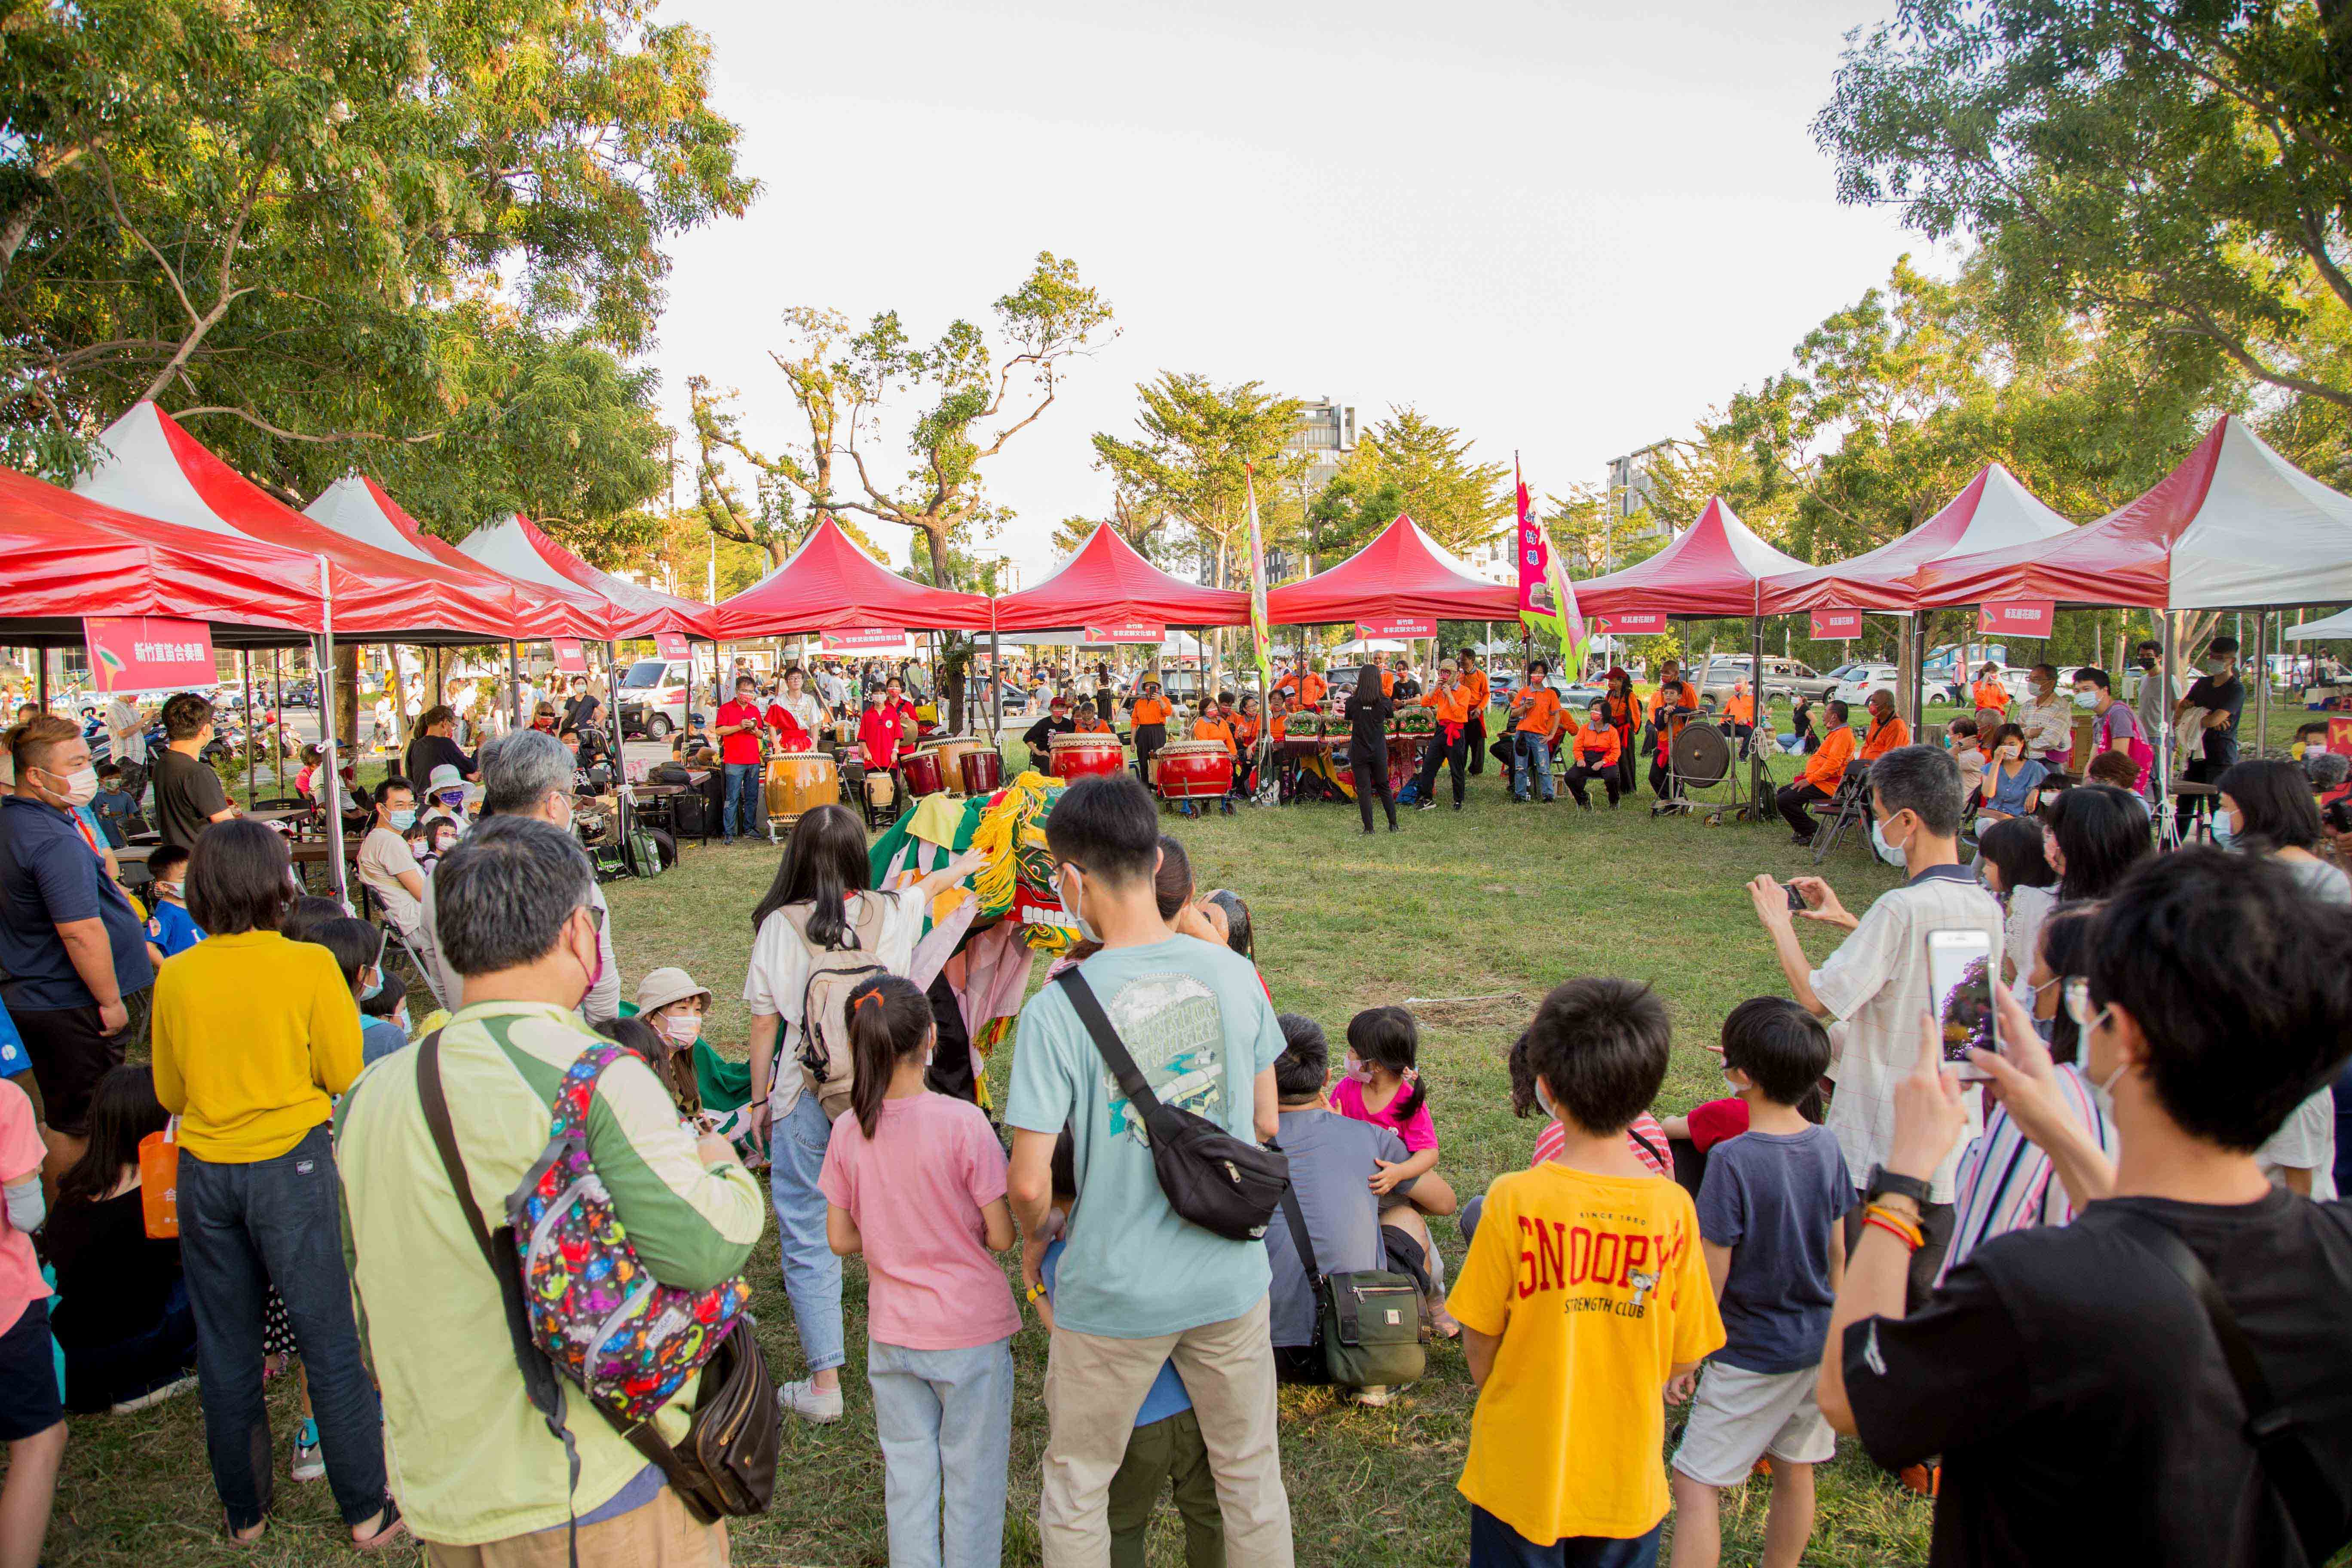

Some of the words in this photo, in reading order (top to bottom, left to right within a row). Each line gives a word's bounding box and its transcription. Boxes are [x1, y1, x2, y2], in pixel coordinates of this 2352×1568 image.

[1525, 509, 1539, 566] 新竹縣
[2004, 608, 2041, 620] 新瓦屋花鼓隊
[134, 642, 205, 662] 新竹直笛合奏團
[598, 863, 624, 871] NTRITION
[1580, 1212, 1613, 1220] SINCE
[1565, 1296, 1613, 1314] STRENGTH
[1615, 1302, 1645, 1319] CLUB
